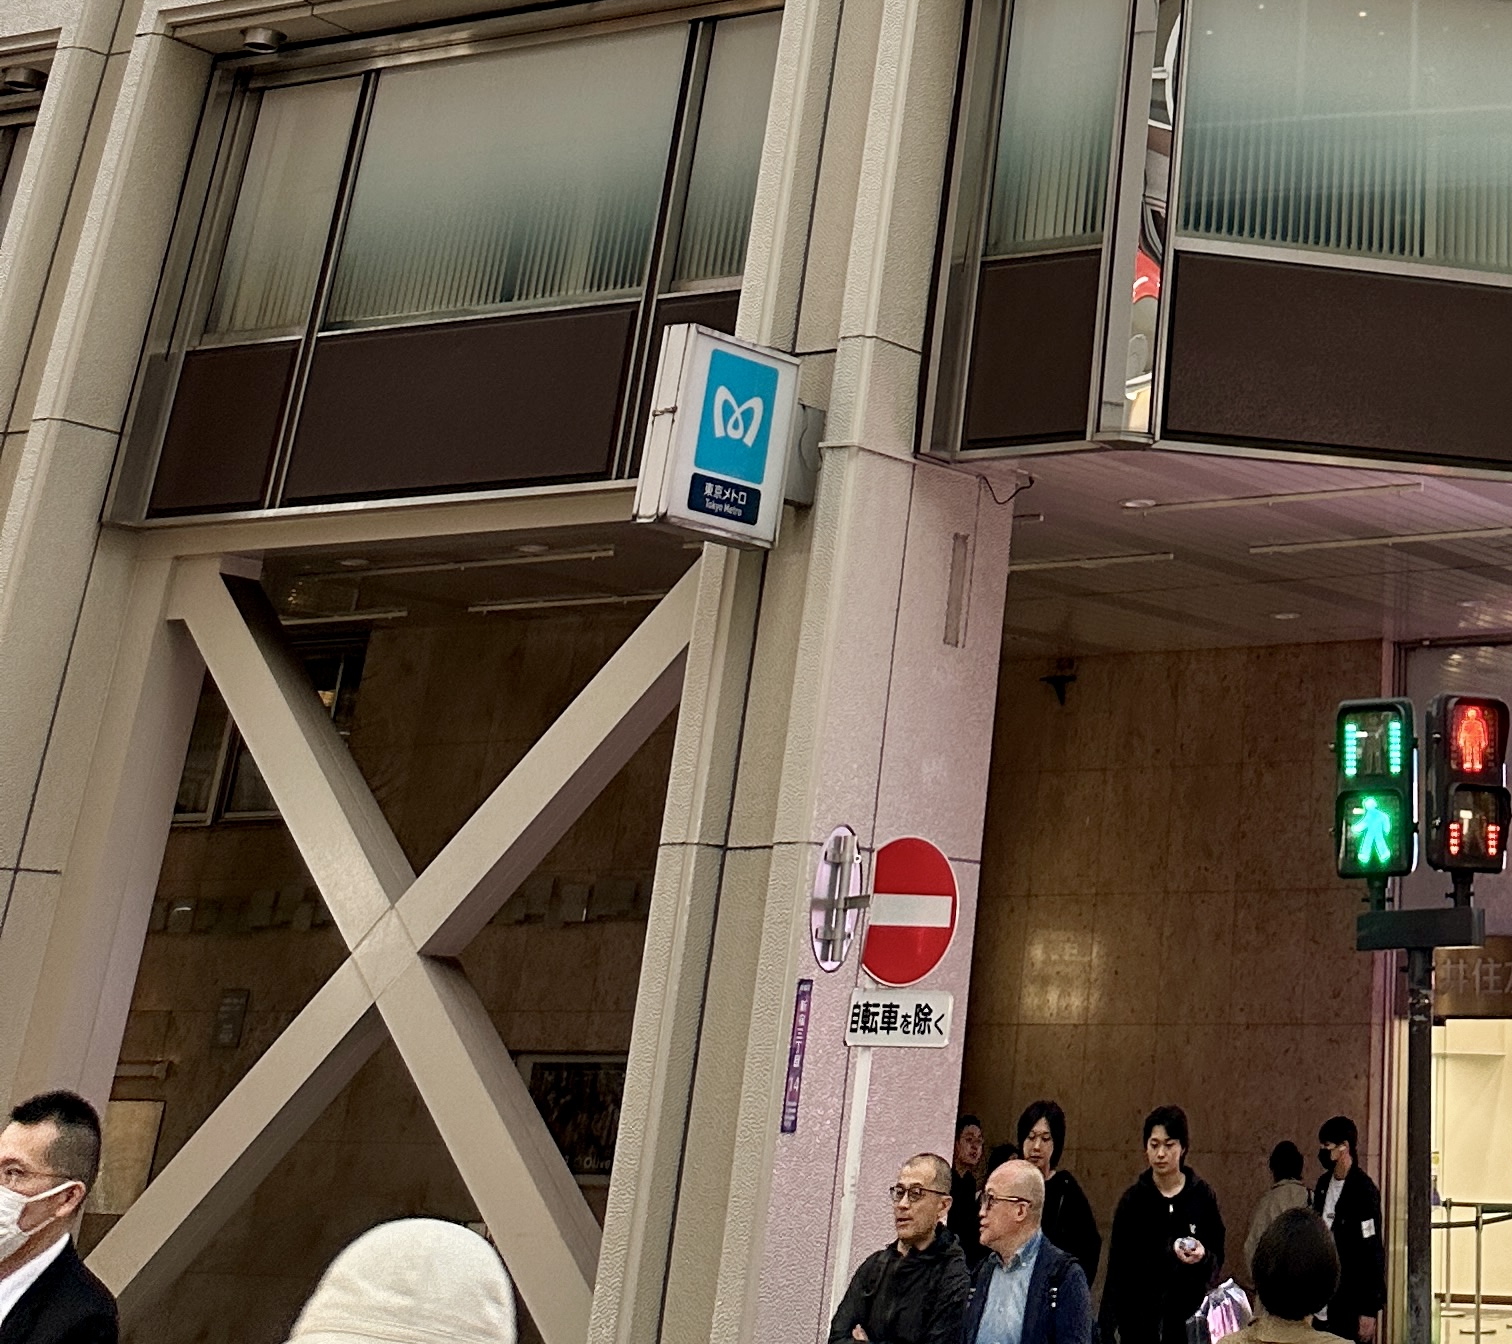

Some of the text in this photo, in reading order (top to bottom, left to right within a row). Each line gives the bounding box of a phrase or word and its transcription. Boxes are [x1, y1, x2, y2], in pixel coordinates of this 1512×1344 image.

[703, 482, 747, 505] 東京メトロ
[705, 497, 743, 517] Tokyo Metro
[850, 1001, 945, 1035] 自転車を除く
